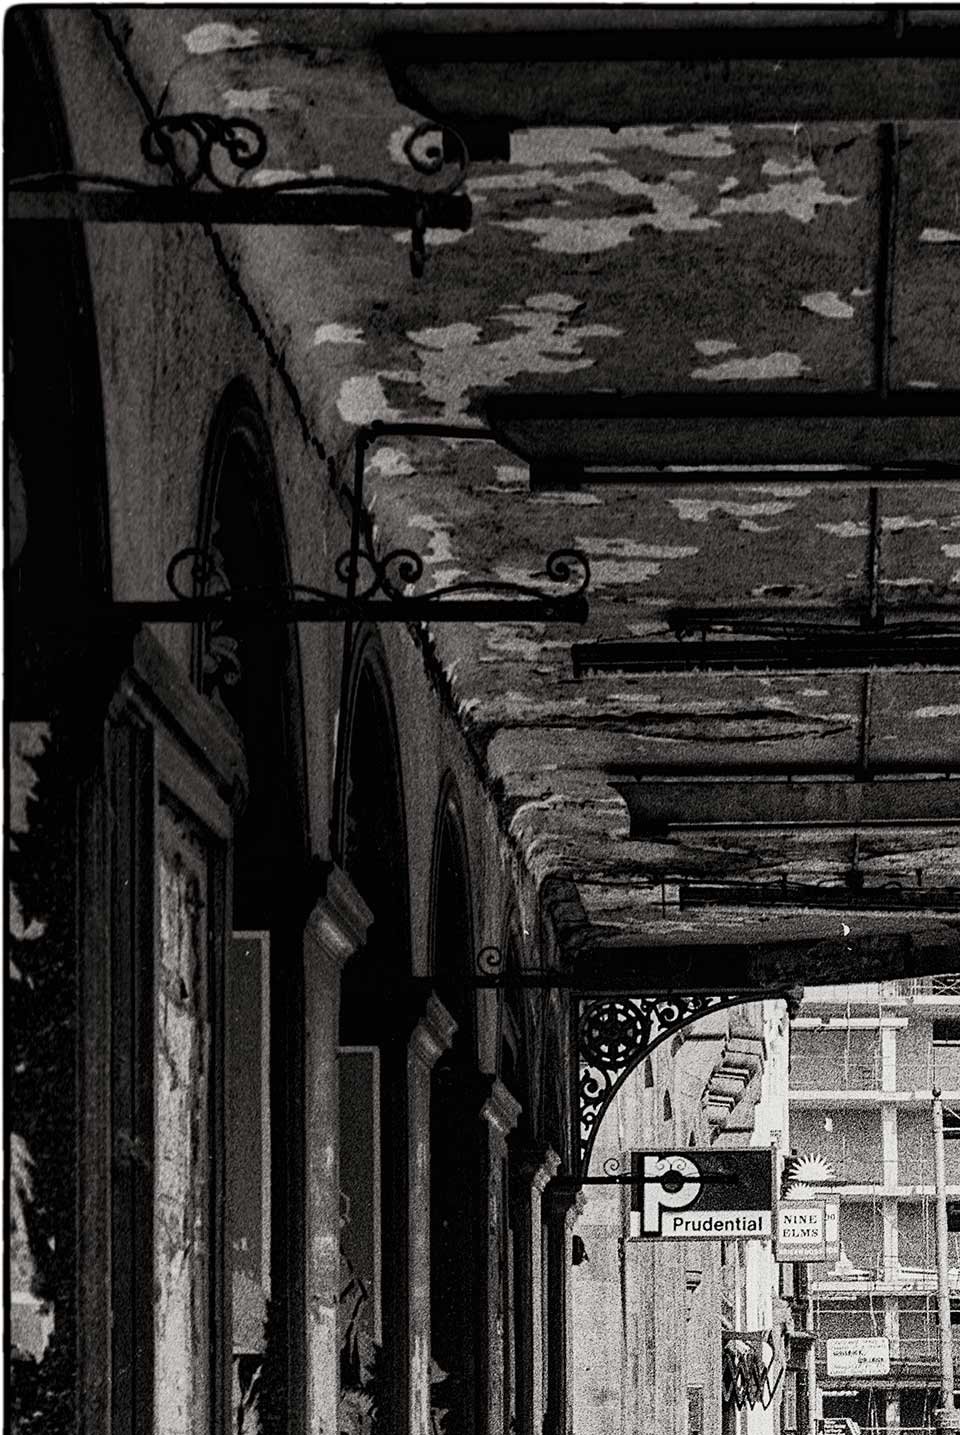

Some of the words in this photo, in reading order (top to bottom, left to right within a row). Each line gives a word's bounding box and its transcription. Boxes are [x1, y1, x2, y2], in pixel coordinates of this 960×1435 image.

[672, 1216, 763, 1232] Prudential
[783, 1215, 818, 1224] NINE
[782, 1228, 819, 1238] ELMS
